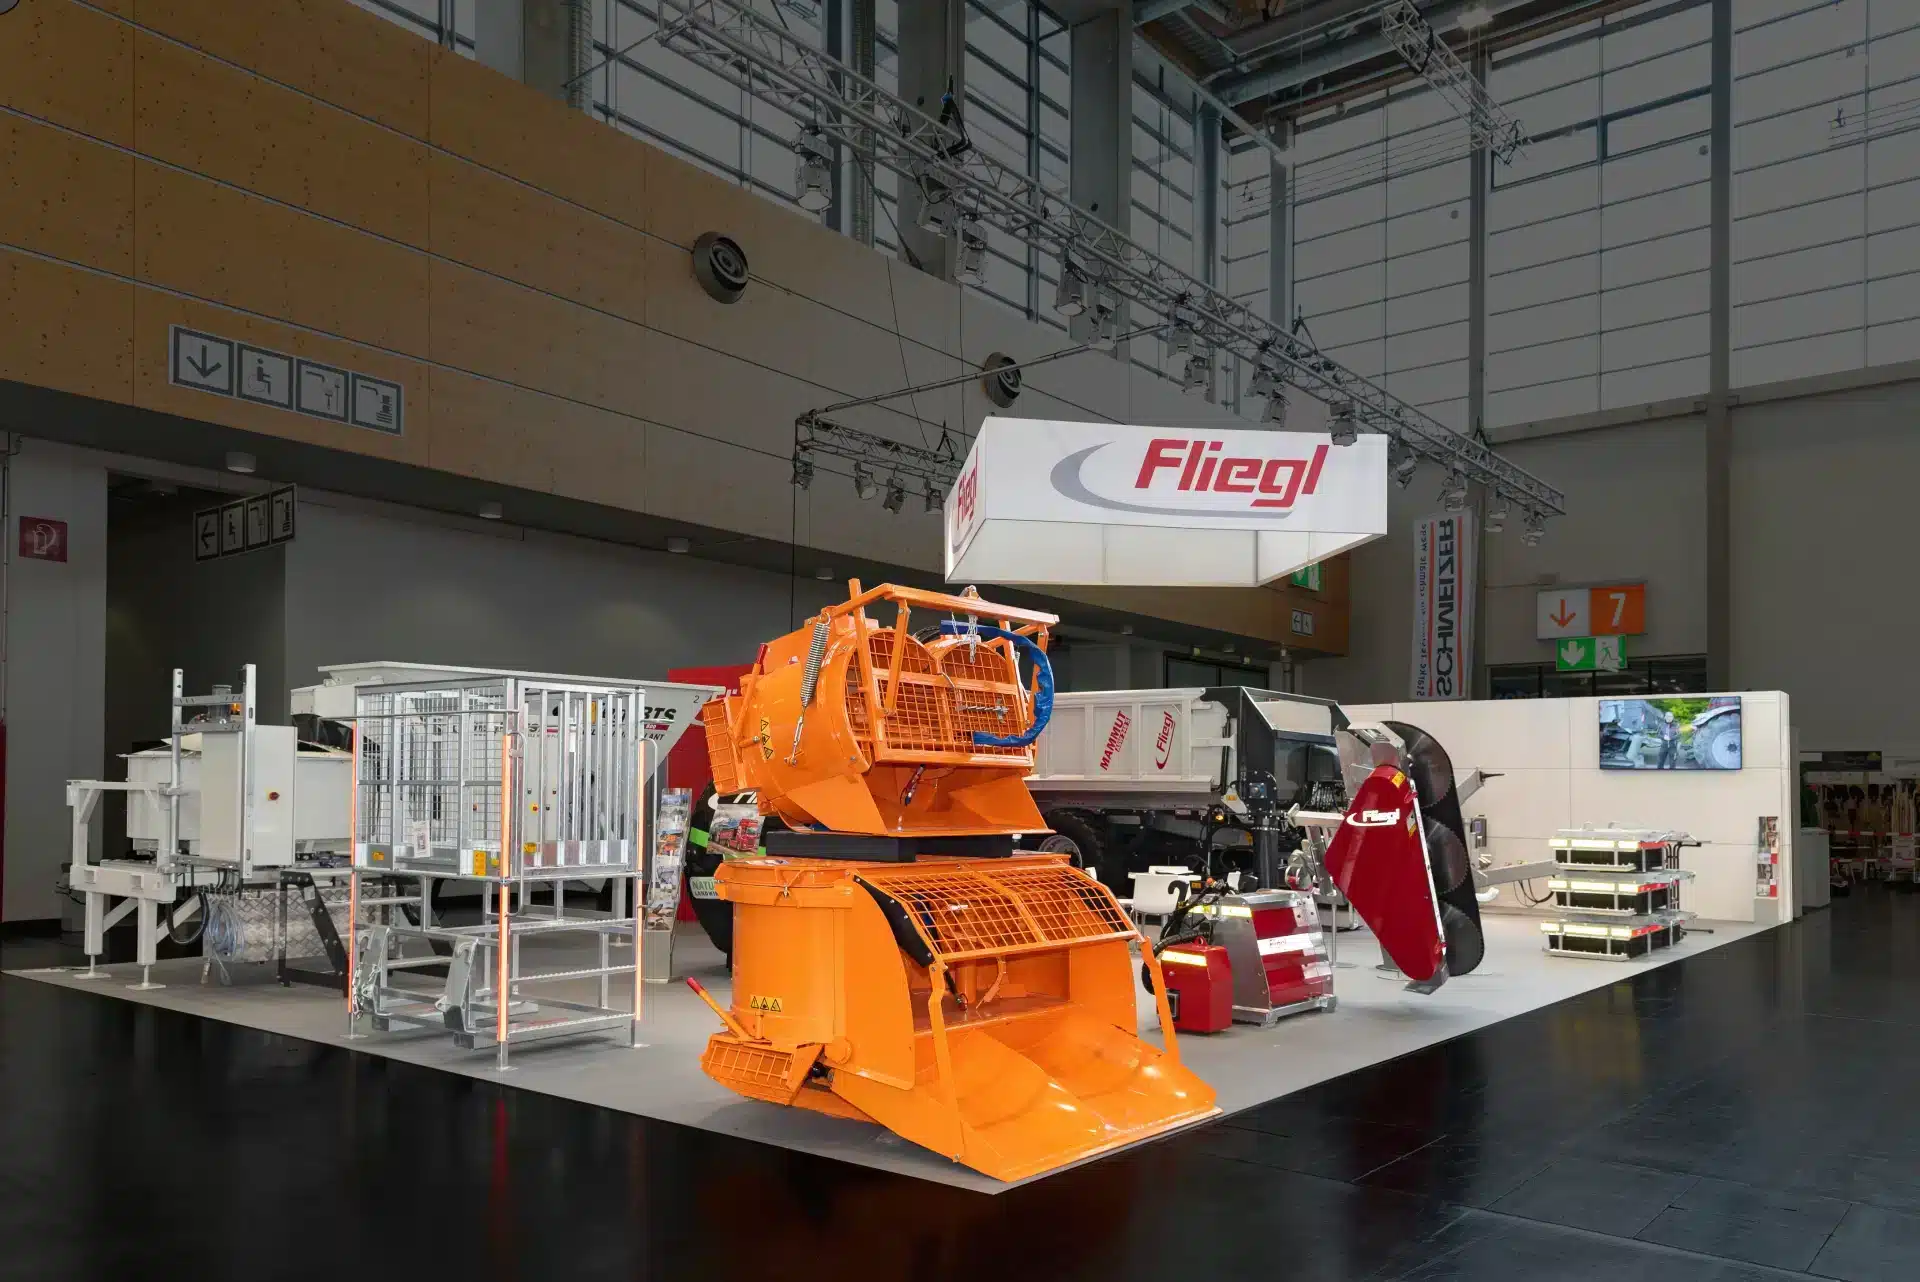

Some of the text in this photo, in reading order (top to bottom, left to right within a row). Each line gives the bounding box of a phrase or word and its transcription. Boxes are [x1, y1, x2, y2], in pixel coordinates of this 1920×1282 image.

[957, 446, 978, 530] Fliegl
[1135, 438, 1329, 508] Fliegl
[1610, 592, 1626, 627] 7
[693, 695, 700, 704] 2
[1100, 710, 1126, 771] MAMMUT
[1156, 711, 1174, 752] Fliegl
